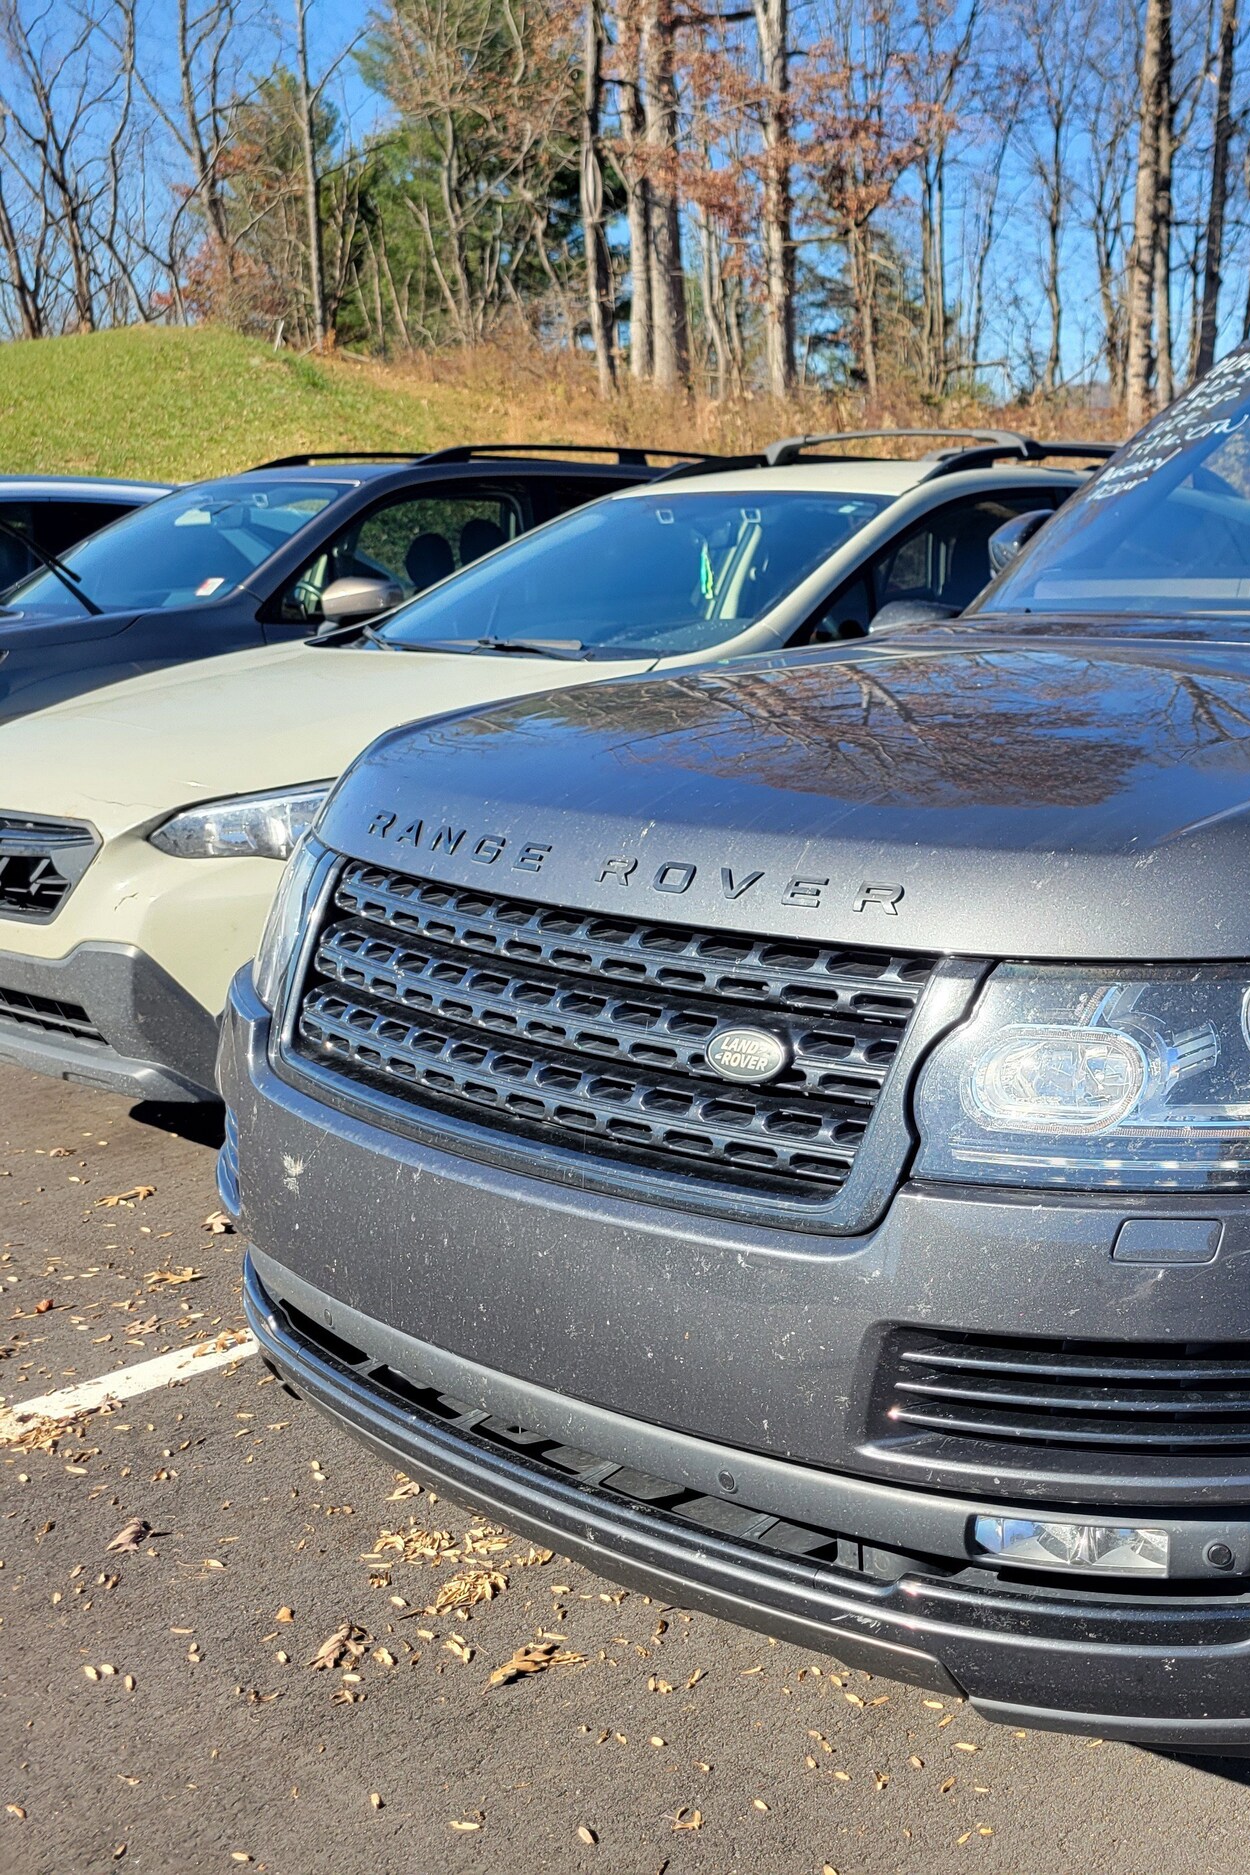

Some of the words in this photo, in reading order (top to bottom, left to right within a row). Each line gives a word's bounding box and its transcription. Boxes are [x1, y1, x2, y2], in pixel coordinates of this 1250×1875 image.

[368, 809, 553, 873] RANGE
[594, 854, 906, 916] ROVER
[720, 1036, 760, 1055] LAND
[720, 1051, 769, 1072] ROVER
